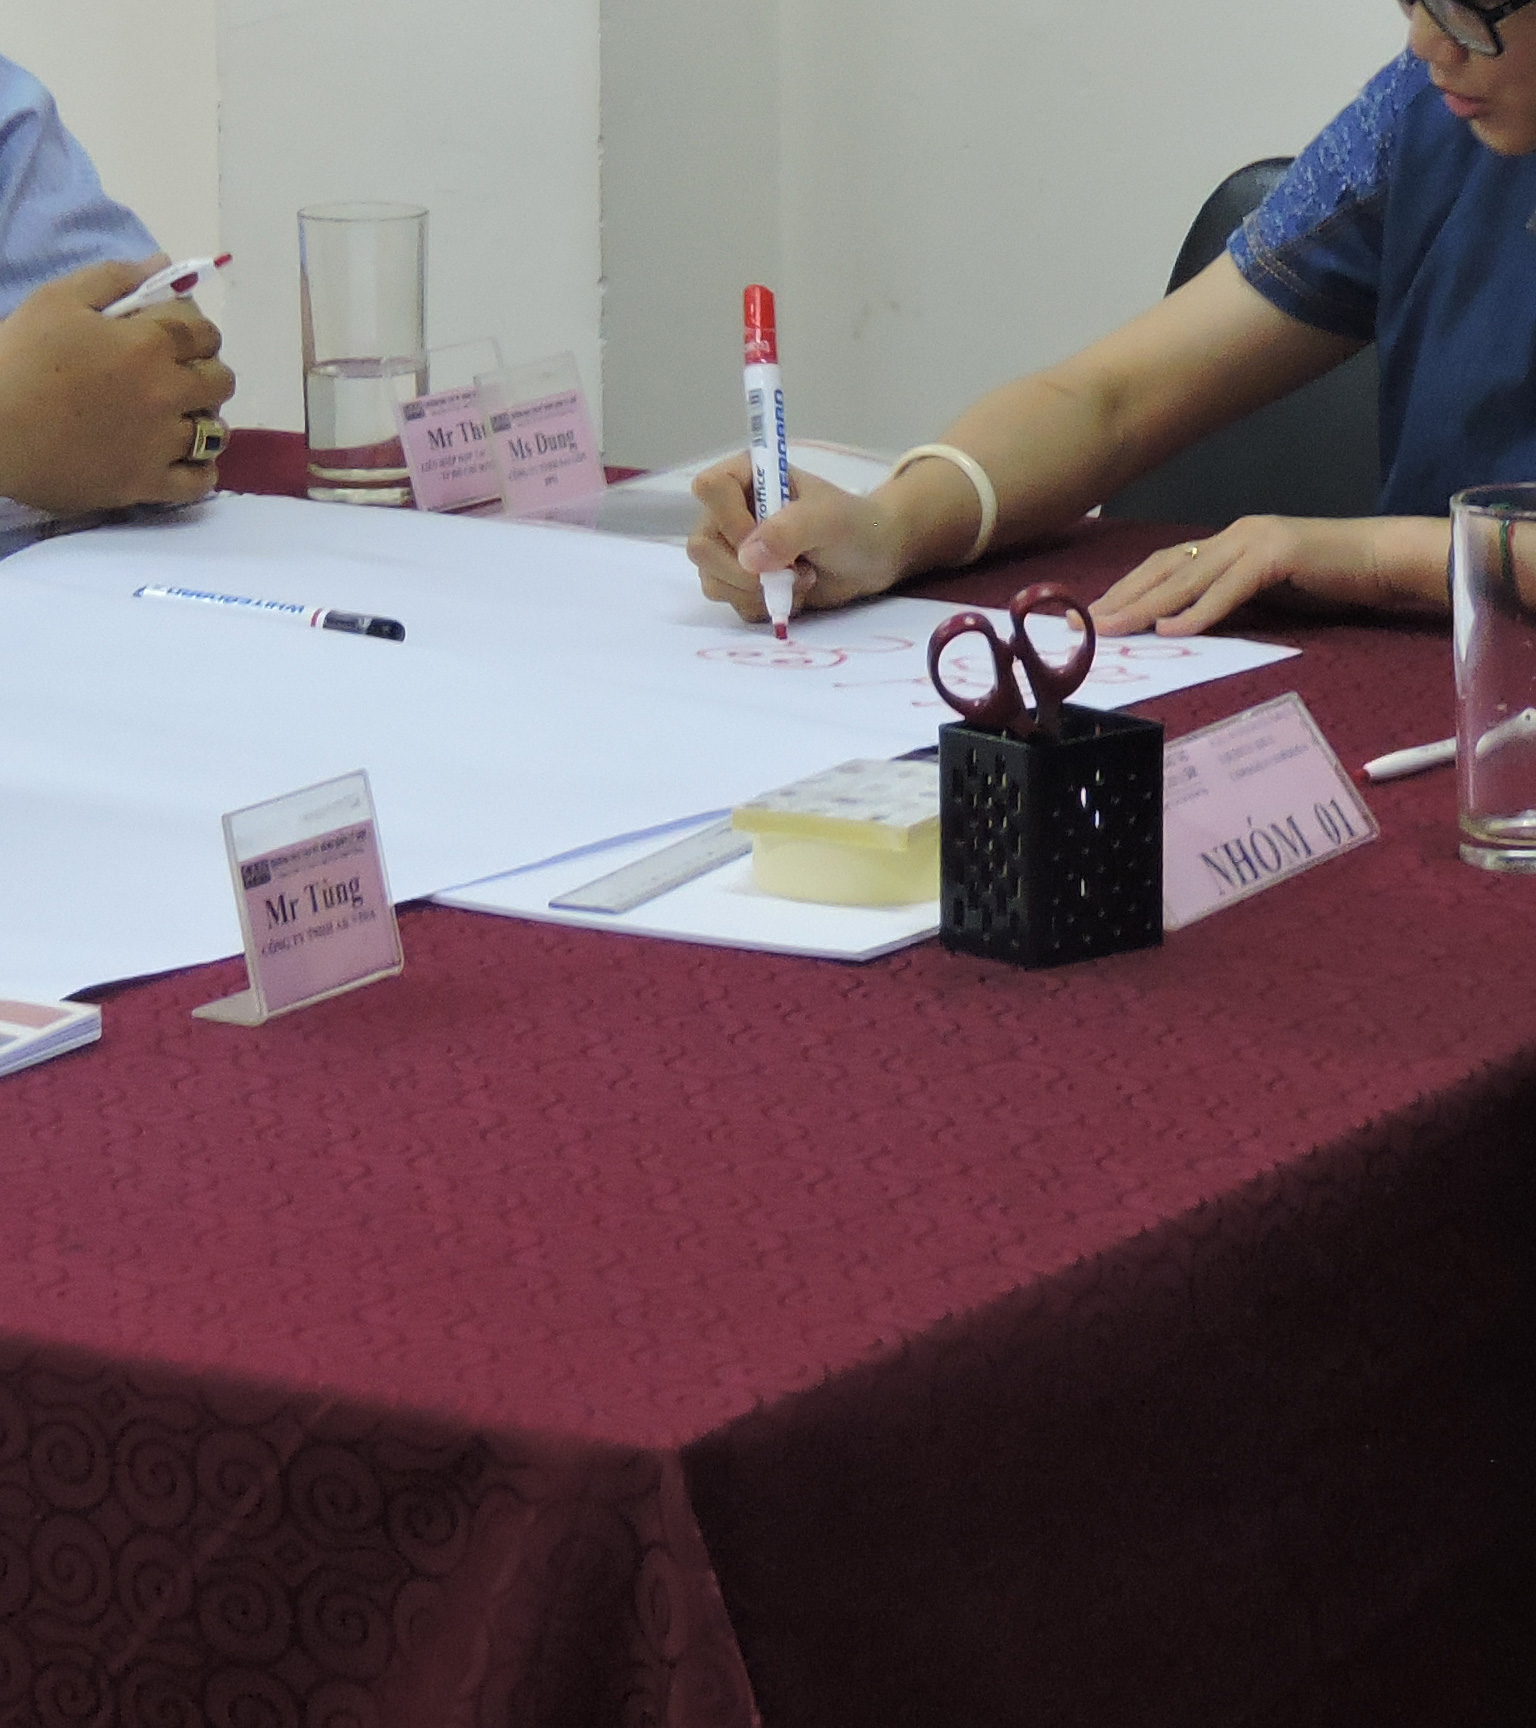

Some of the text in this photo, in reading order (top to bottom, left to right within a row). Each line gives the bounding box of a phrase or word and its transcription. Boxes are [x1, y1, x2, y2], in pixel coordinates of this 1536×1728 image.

[427, 425, 455, 451] Mr
[508, 436, 532, 461] Ms
[1199, 798, 1359, 897] NHÓM 01
[264, 891, 300, 930] Mr
